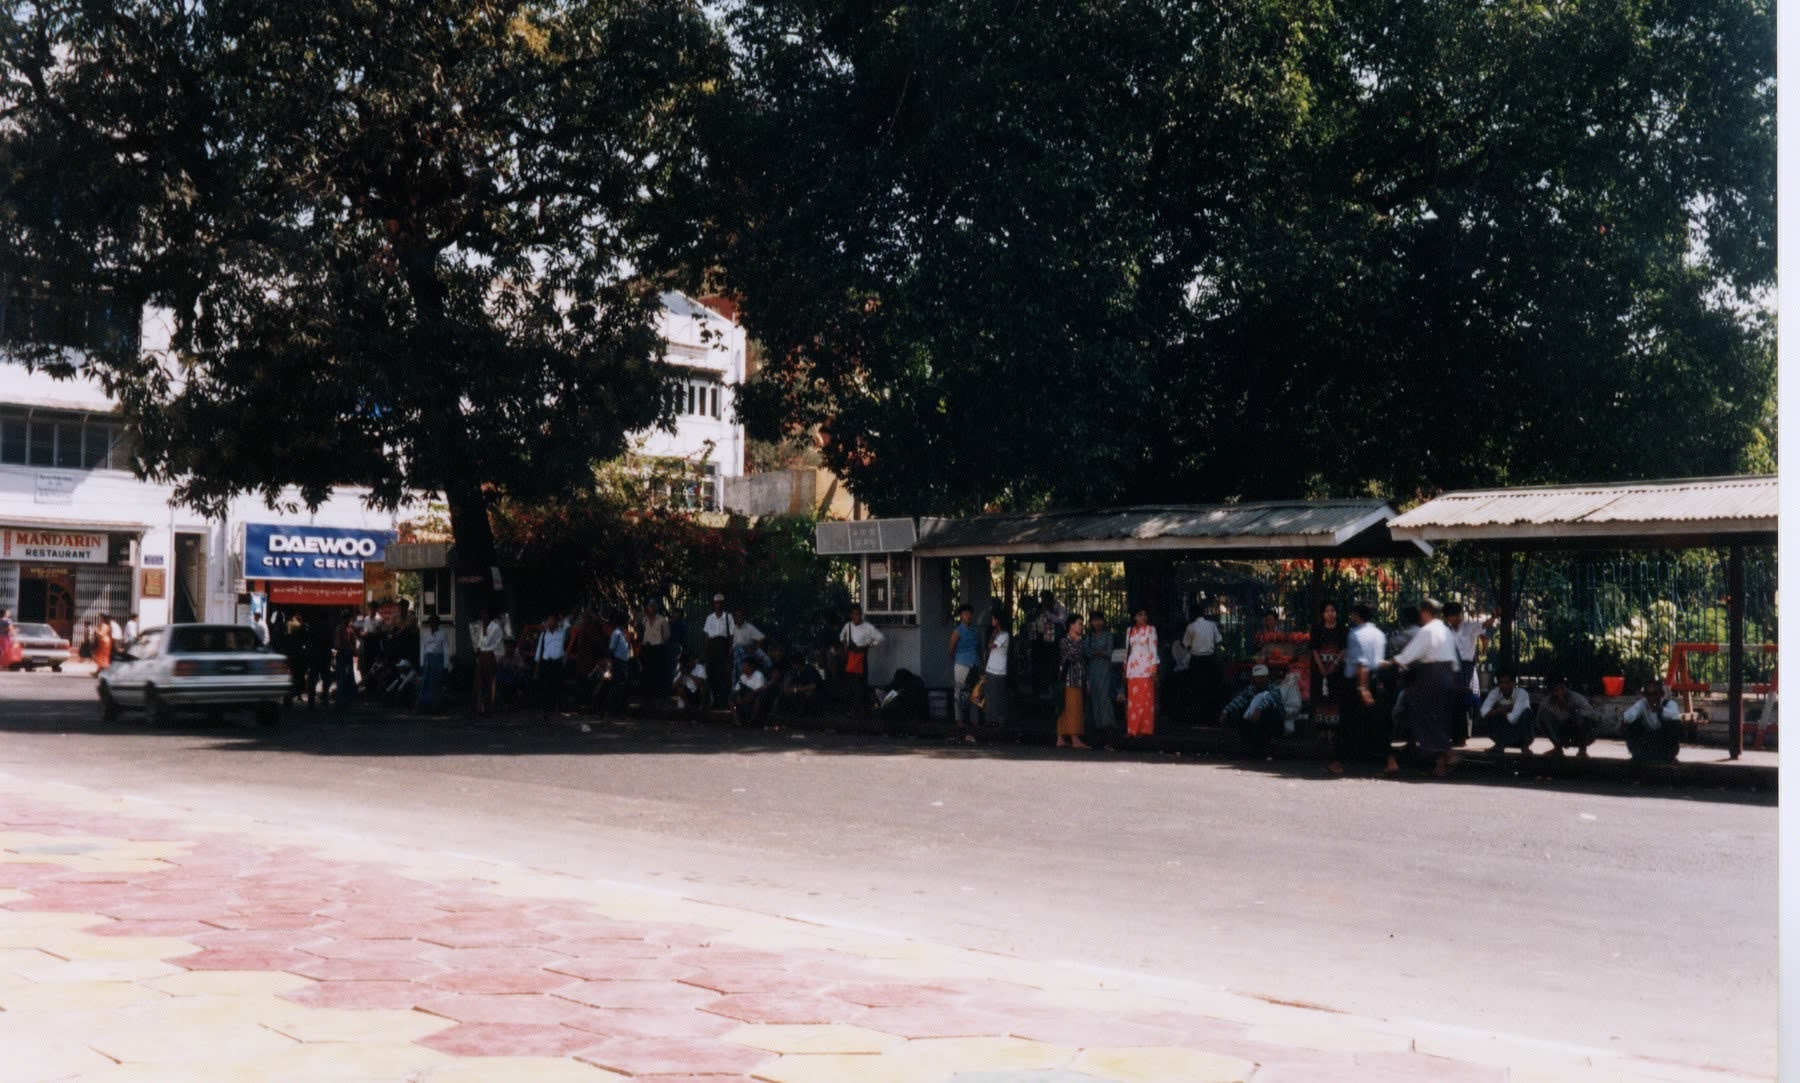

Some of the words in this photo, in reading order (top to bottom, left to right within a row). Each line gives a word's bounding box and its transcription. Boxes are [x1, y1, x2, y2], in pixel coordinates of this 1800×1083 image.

[17, 533, 101, 547] MANDARIN
[269, 535, 376, 556] DAEWOO
[26, 549, 91, 559] RESTAURANT
[263, 557, 304, 567] CITY
